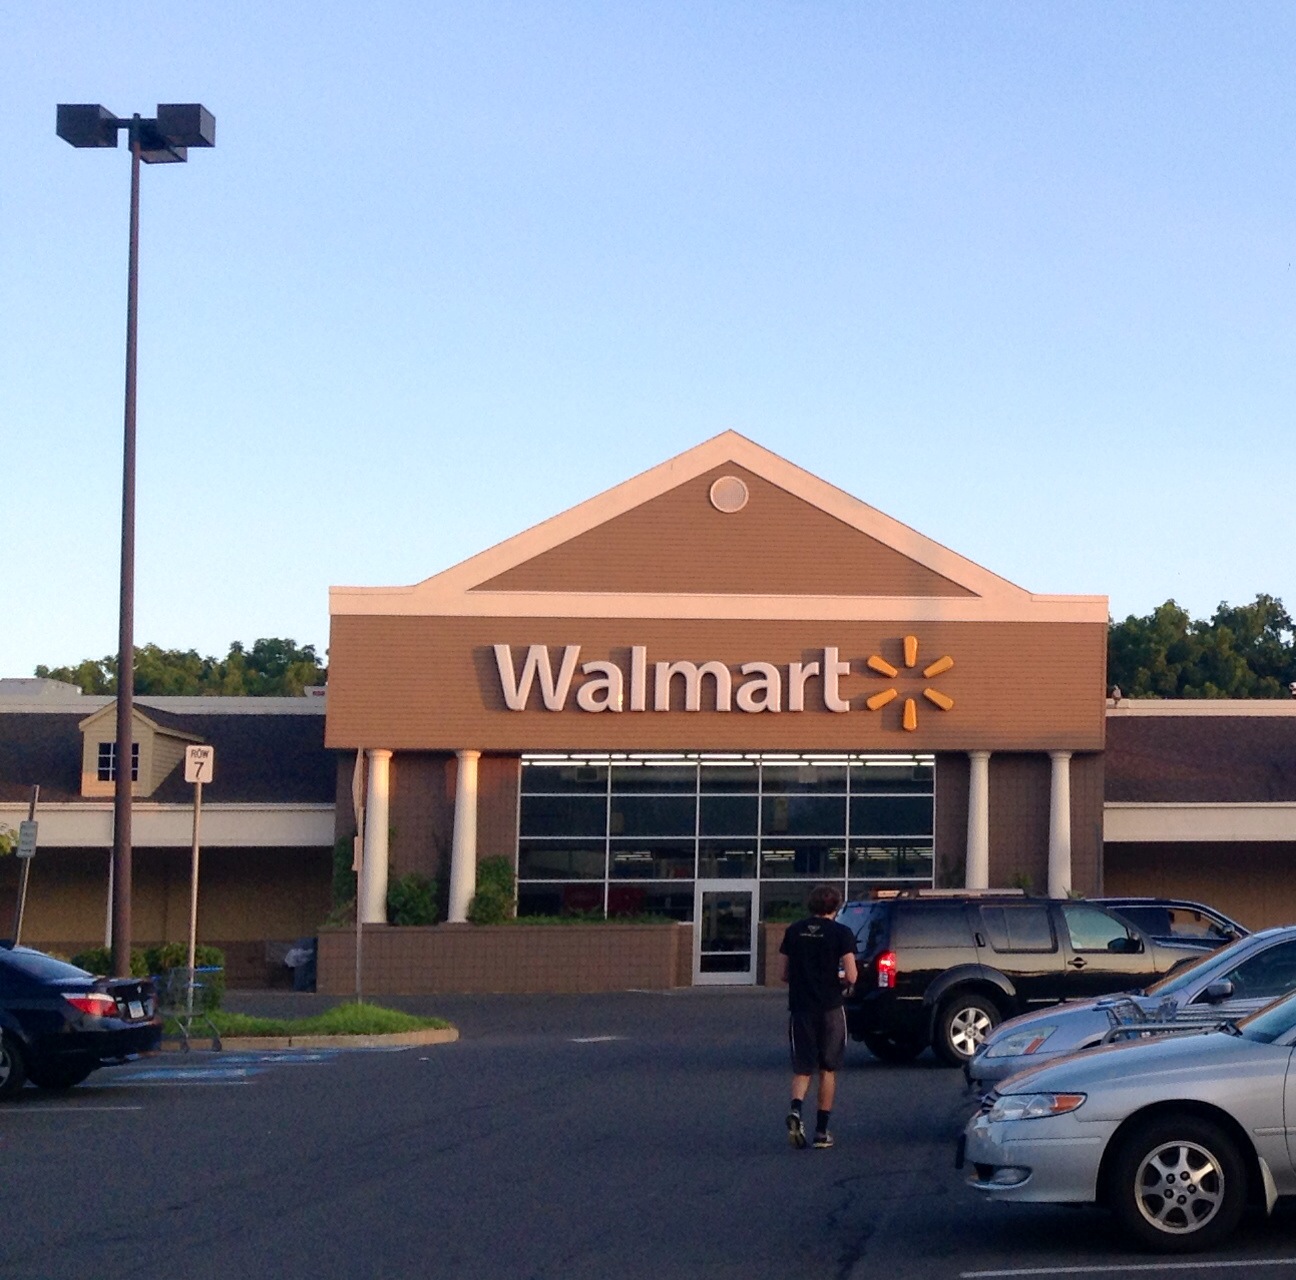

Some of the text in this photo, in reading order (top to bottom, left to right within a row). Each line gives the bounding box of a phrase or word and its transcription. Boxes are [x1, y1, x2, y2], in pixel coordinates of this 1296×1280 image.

[493, 644, 850, 713] Walmart
[190, 748, 210, 759] ROW
[194, 761, 204, 778] 7
